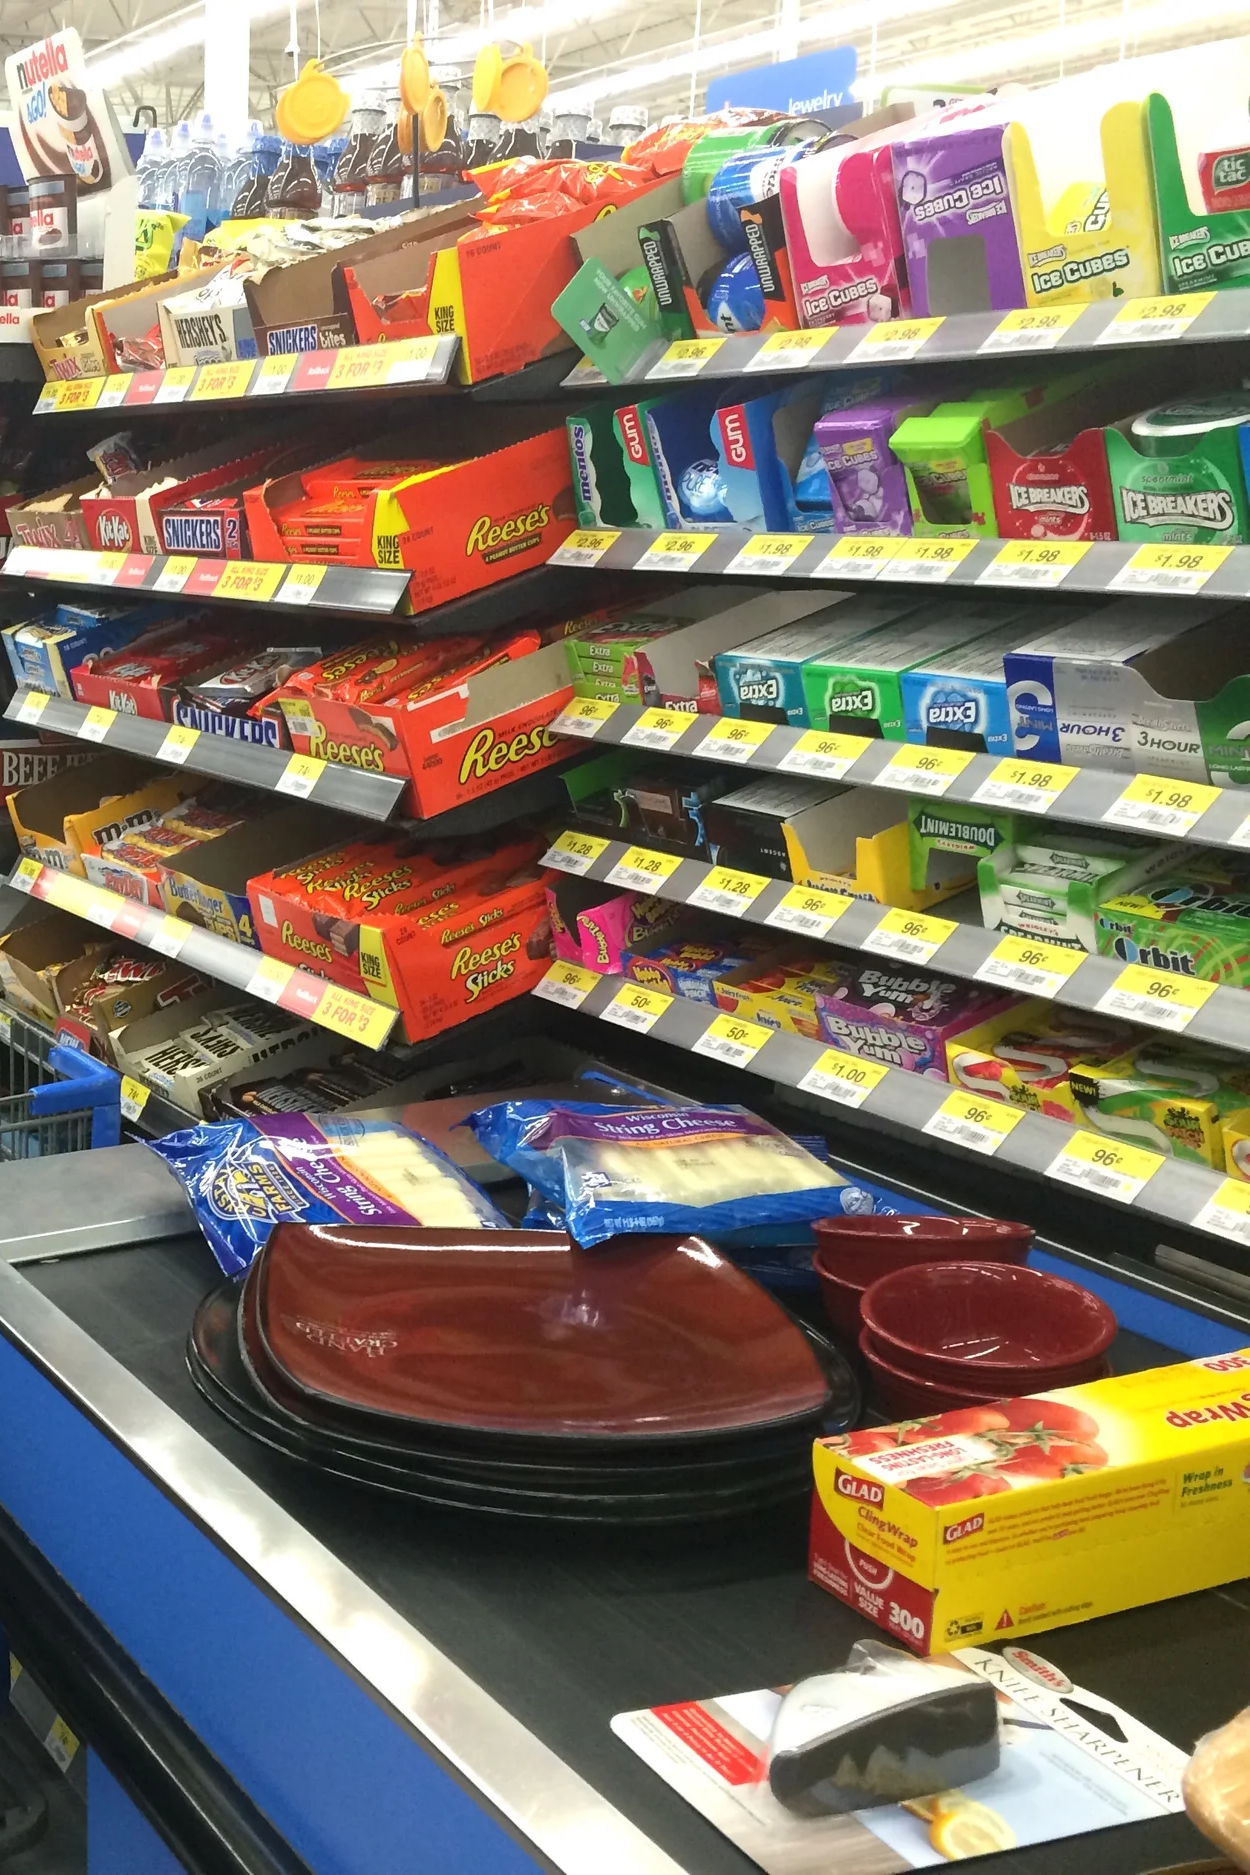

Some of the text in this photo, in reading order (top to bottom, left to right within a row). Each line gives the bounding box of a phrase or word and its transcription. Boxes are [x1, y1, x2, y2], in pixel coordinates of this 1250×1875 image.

[16, 37, 69, 90] nutella
[1223, 156, 1245, 173] tic
[1219, 166, 1247, 184] tac
[745, 223, 776, 292] UNWRAPPED
[642, 240, 672, 306] UNWRAPPED
[434, 305, 455, 321] KING
[1138, 302, 1187, 320] $2.98
[174, 313, 227, 349] HERSHEY'S
[435, 319, 456, 333] SIZE
[1017, 315, 1062, 331] $2.98
[268, 325, 318, 356] SNICKERS
[319, 330, 346, 349] bites
[572, 424, 592, 503] mentos
[1140, 472, 1195, 485] spearmint
[1009, 483, 1089, 511] ICE BREAKERS
[1121, 487, 1233, 528] ICE BREAKERS
[163, 518, 221, 551] SNICKERS
[226, 518, 237, 539] 2
[465, 503, 551, 557] Reese's
[1161, 530, 1193, 543] mints
[377, 534, 400, 550] KING
[577, 537, 605, 549] $2.96
[664, 540, 694, 552] $2.96
[759, 543, 793, 556] $1.98
[848, 544, 884, 558] $1.98
[377, 550, 401, 565] SIZE
[915, 546, 954, 560] $1.98
[1017, 548, 1061, 564] $1.98
[1154, 553, 1204, 570] $1.98
[221, 575, 230, 589] 3
[231, 576, 252, 590] FOR
[589, 645, 611, 657] Extra
[593, 660, 614, 674] Extra
[739, 679, 778, 700] Extra
[579, 705, 599, 717] 96¢
[664, 699, 698, 713] Extra
[831, 690, 874, 713] Extra
[928, 701, 977, 724] Extra
[653, 717, 674, 729] 96¢
[1059, 720, 1126, 743] 3 HOUR
[727, 728, 750, 740] 96¢
[1136, 730, 1201, 755] 3 HOUR
[309, 720, 384, 773] Reese's
[815, 741, 840, 753] 96¢
[2, 750, 59, 787] BEEF
[915, 757, 944, 770] 96¢
[1010, 770, 1054, 787] $1.98
[1146, 788, 1193, 808] $1.98
[920, 814, 995, 846] DOUBLEMINT
[566, 839, 594, 856] $1.28
[633, 855, 663, 873] $1.28
[344, 864, 414, 902] Reese's
[718, 877, 752, 894] $1.28
[169, 876, 224, 915] Butterfinger
[361, 877, 413, 911] Sticks
[801, 898, 827, 911] 96¢
[237, 914, 252, 939] 4
[439, 907, 505, 946] Reese's Sticks
[900, 921, 928, 937] 96¢
[1017, 922, 1060, 937] WRIGLEY'S
[1100, 917, 1134, 935] Orbit
[280, 918, 333, 965] Reese's
[360, 951, 381, 969] KING
[450, 931, 523, 981] Reese's
[1018, 949, 1050, 966] 96¢
[1112, 936, 1196, 977] Orbit
[362, 963, 382, 980] SIZE
[464, 958, 516, 1004] Sticks
[561, 972, 582, 985] 96¢
[858, 968, 956, 996] Bubble
[1146, 981, 1182, 999] 96¢
[330, 991, 376, 1016] ALL KING SIZE
[630, 995, 651, 1008] 50¢
[861, 986, 915, 1006] Yum
[321, 1001, 330, 1015] 3
[331, 1004, 356, 1026] FOR
[725, 1026, 750, 1041] 50¢
[827, 1015, 926, 1052] Bubble
[847, 1037, 902, 1066] Yum
[831, 1062, 867, 1083] $1.00
[1071, 1080, 1098, 1096] NEW!
[625, 1112, 690, 1123] Wisconsin
[964, 1106, 994, 1123] 96¢
[593, 1117, 738, 1136] String Cheese
[1091, 1148, 1124, 1168] 96¢
[248, 1163, 291, 1212] FARMS
[295, 1165, 337, 1200] Wisconsin
[336, 1184, 382, 1216] String
[868, 1440, 956, 1465] FRESHNESS
[1182, 1465, 1225, 1485] Wrap in
[836, 1473, 883, 1504] GLAD
[1180, 1478, 1234, 1498] Freshness
[945, 1515, 984, 1543] GLAD
[876, 1532, 896, 1551] Food
[858, 1558, 878, 1577] PUSH
[853, 1581, 885, 1610] VALUE
[857, 1599, 880, 1619] SIZE
[888, 1601, 926, 1640] 300
[1011, 1649, 1066, 1689] Smith's
[973, 1657, 1048, 1707] KNIFE
[1040, 1706, 1181, 1804] SHARPENER
